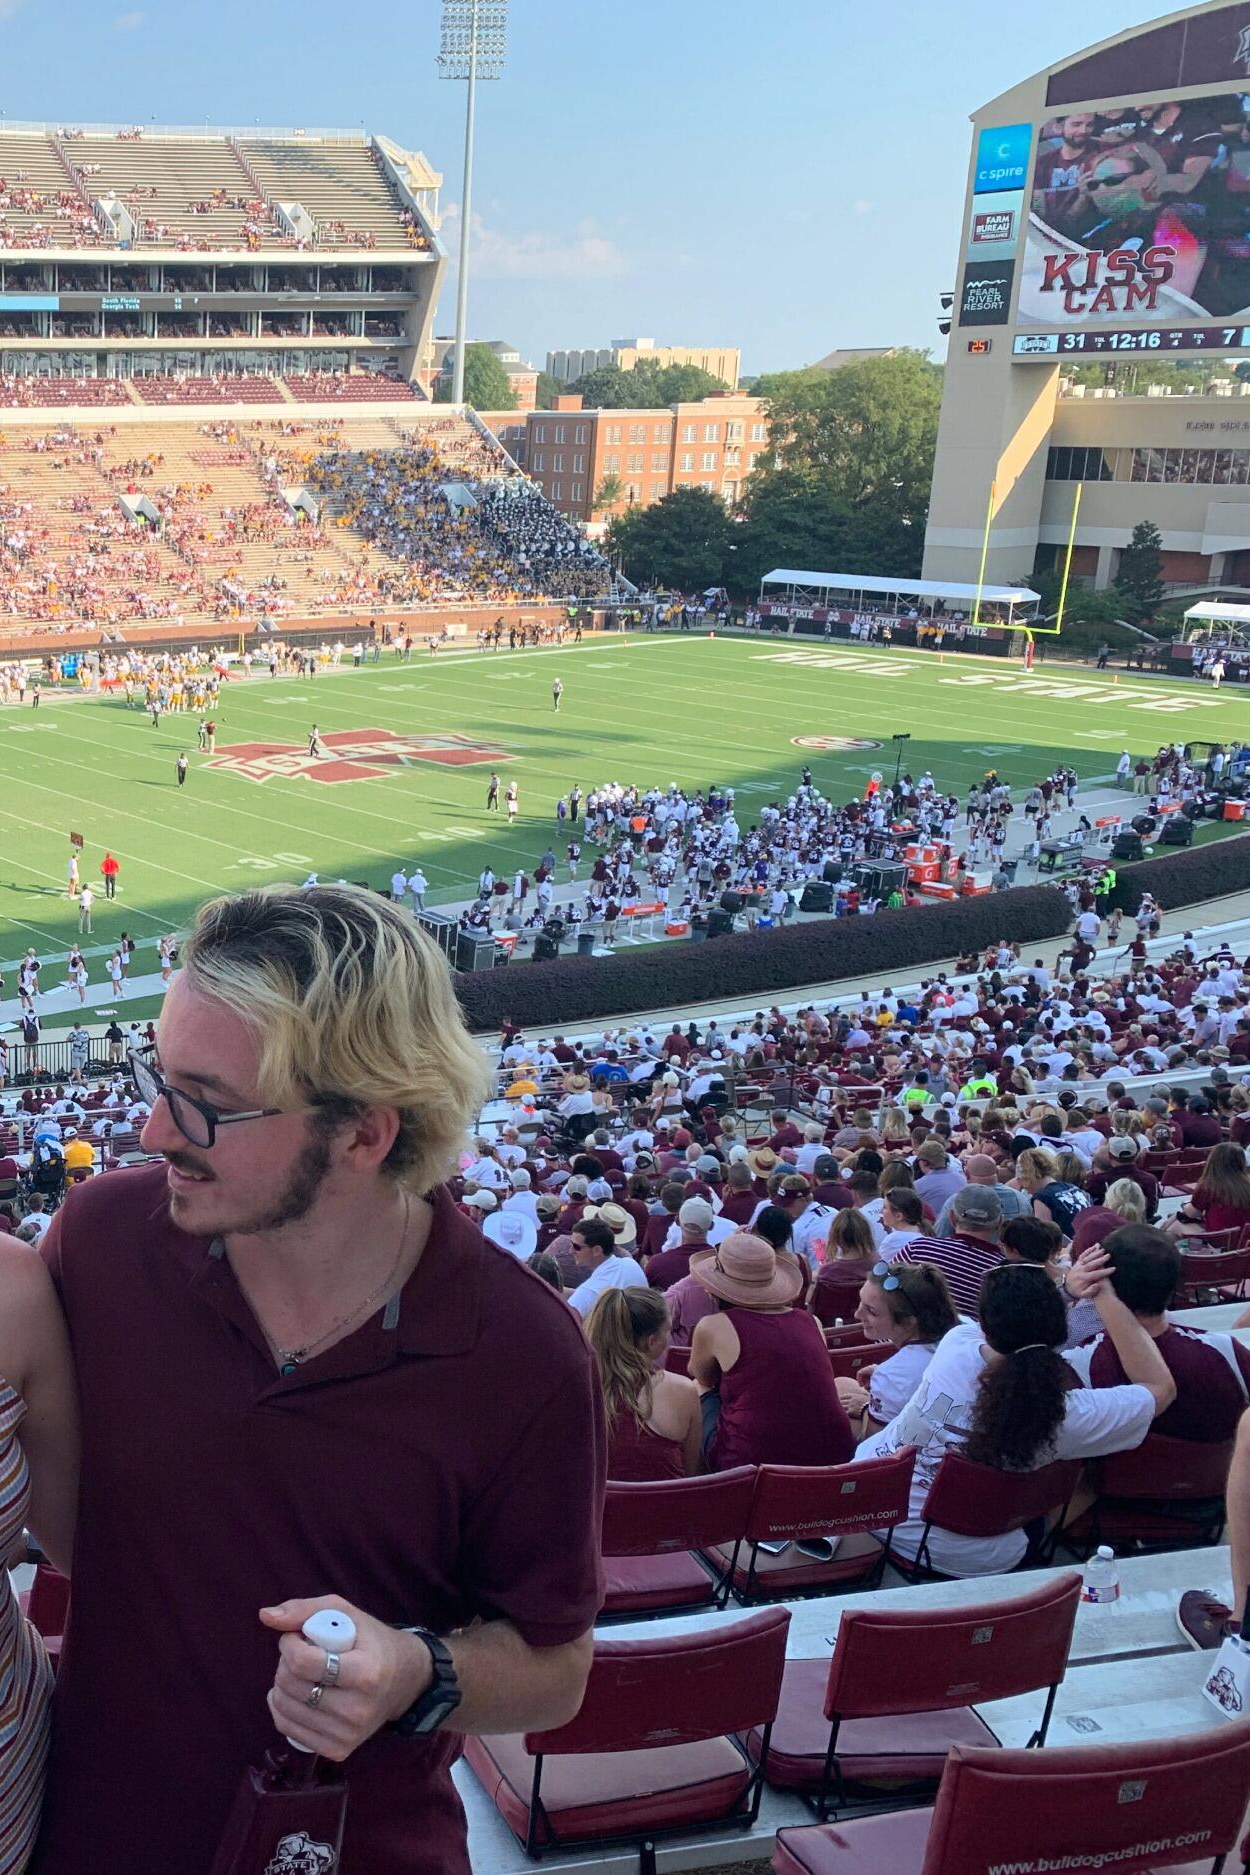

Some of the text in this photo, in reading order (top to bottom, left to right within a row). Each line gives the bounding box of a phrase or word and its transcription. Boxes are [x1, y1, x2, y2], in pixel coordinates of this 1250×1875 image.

[989, 166, 1024, 181] spire
[986, 215, 1010, 224] FARM
[976, 223, 1010, 233] BUREAU
[1039, 246, 1178, 293] KISS
[967, 294, 1002, 303] RIVER
[969, 287, 1001, 296] PEARL
[1063, 280, 1160, 315] CAM
[963, 301, 1005, 311] RESORT
[1063, 333, 1086, 349] 31
[1109, 332, 1161, 349] 12:16
[1222, 329, 1237, 345] 7
[770, 606, 814, 619] HAIL STATE
[854, 613, 901, 628] HAIL STATE
[959, 624, 988, 637] STATE
[748, 651, 1227, 712] HAIL STATE
[238, 852, 313, 870] 30
[924, 866, 935, 879] G
[768, 1509, 899, 1533] www.bulldogcushion.com
[988, 1829, 1212, 1875] www.bulldogcushion.com
[273, 1861, 308, 1874] STATE
